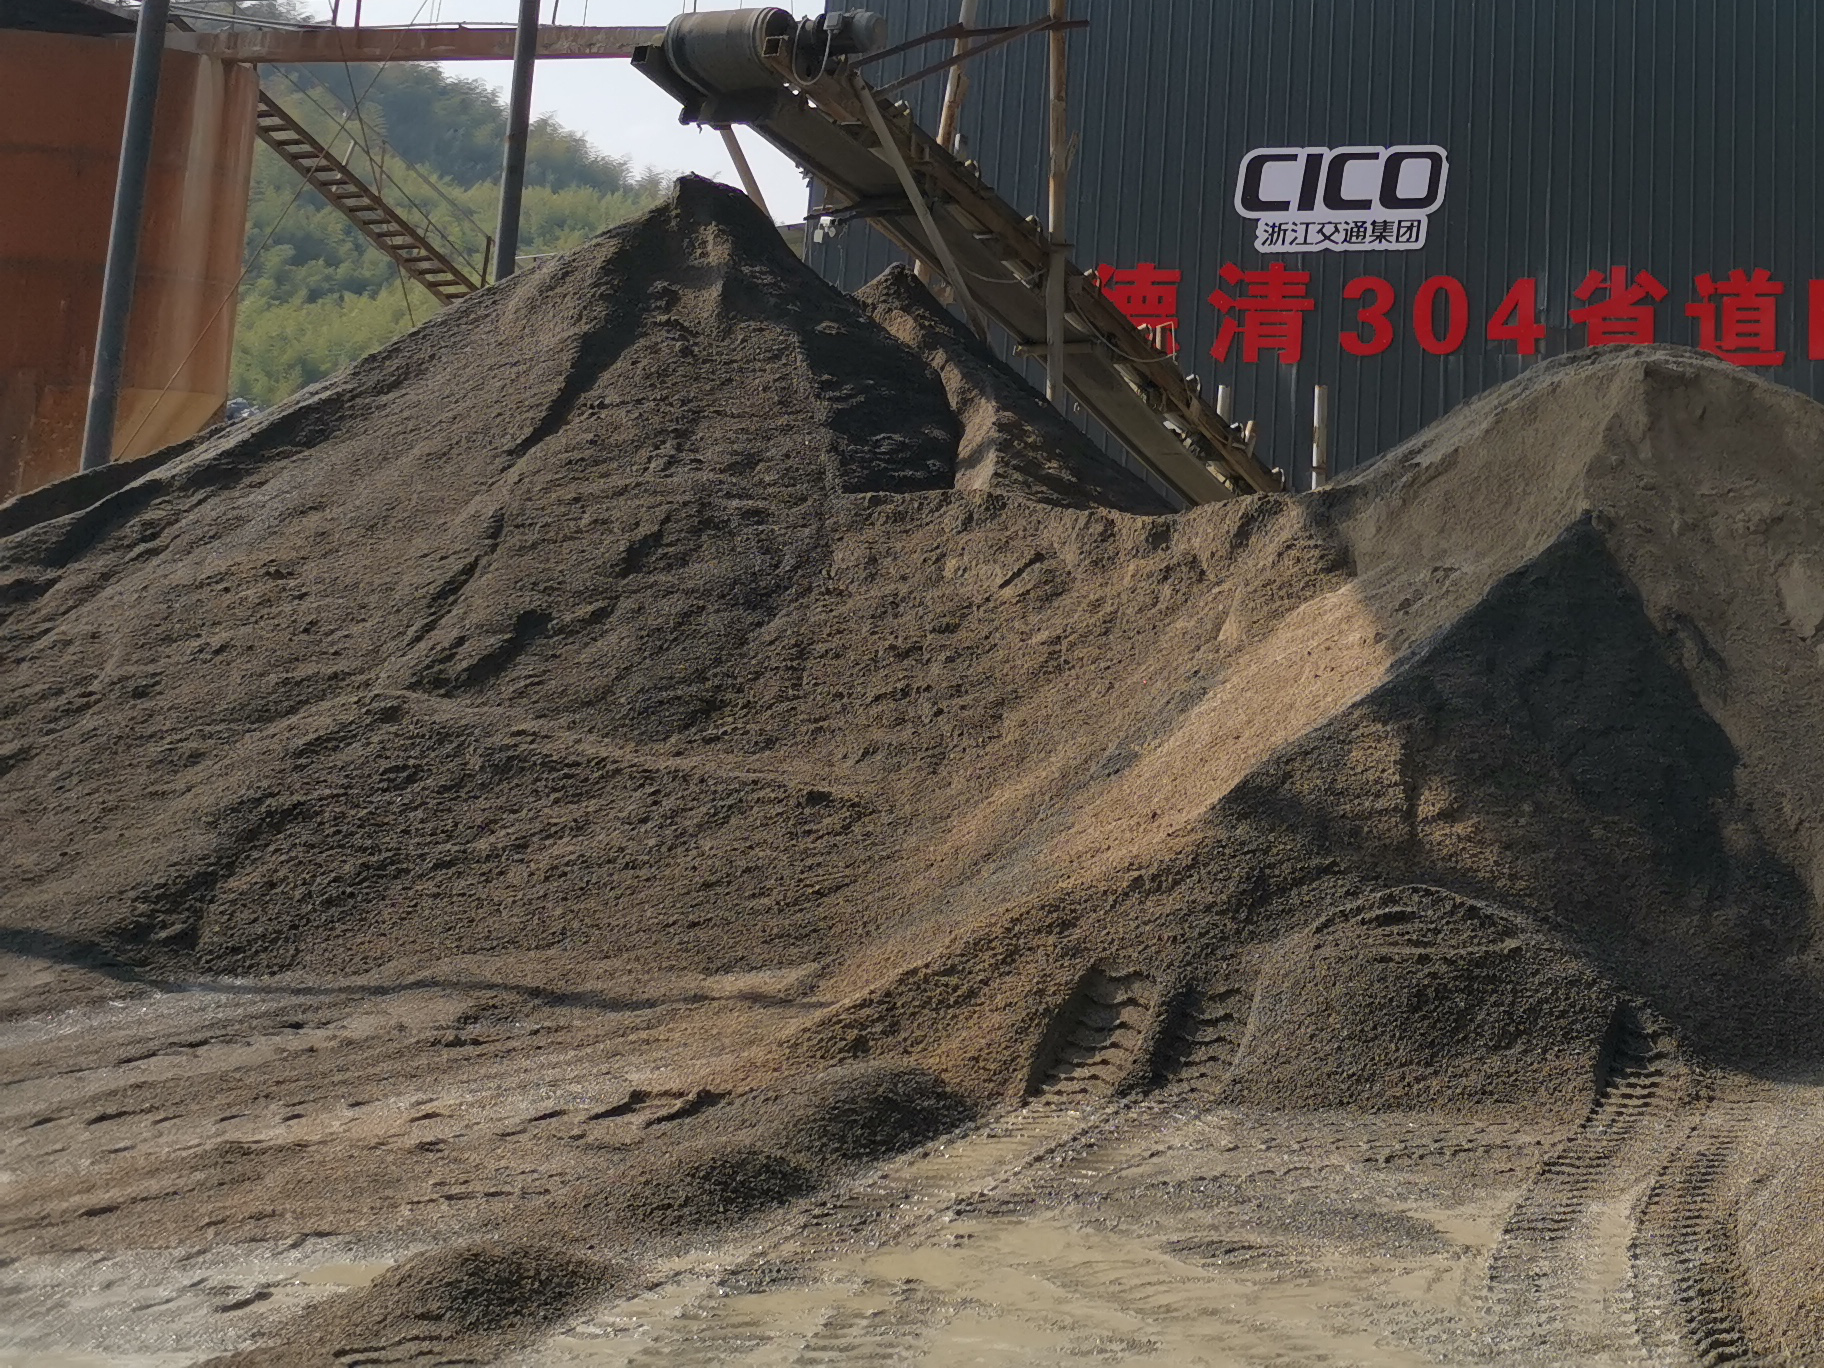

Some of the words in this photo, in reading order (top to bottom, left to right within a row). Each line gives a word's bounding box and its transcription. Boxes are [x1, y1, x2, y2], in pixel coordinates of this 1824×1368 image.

[1241, 152, 1443, 212] CICO
[1261, 219, 1422, 246] 浙江交通集团
